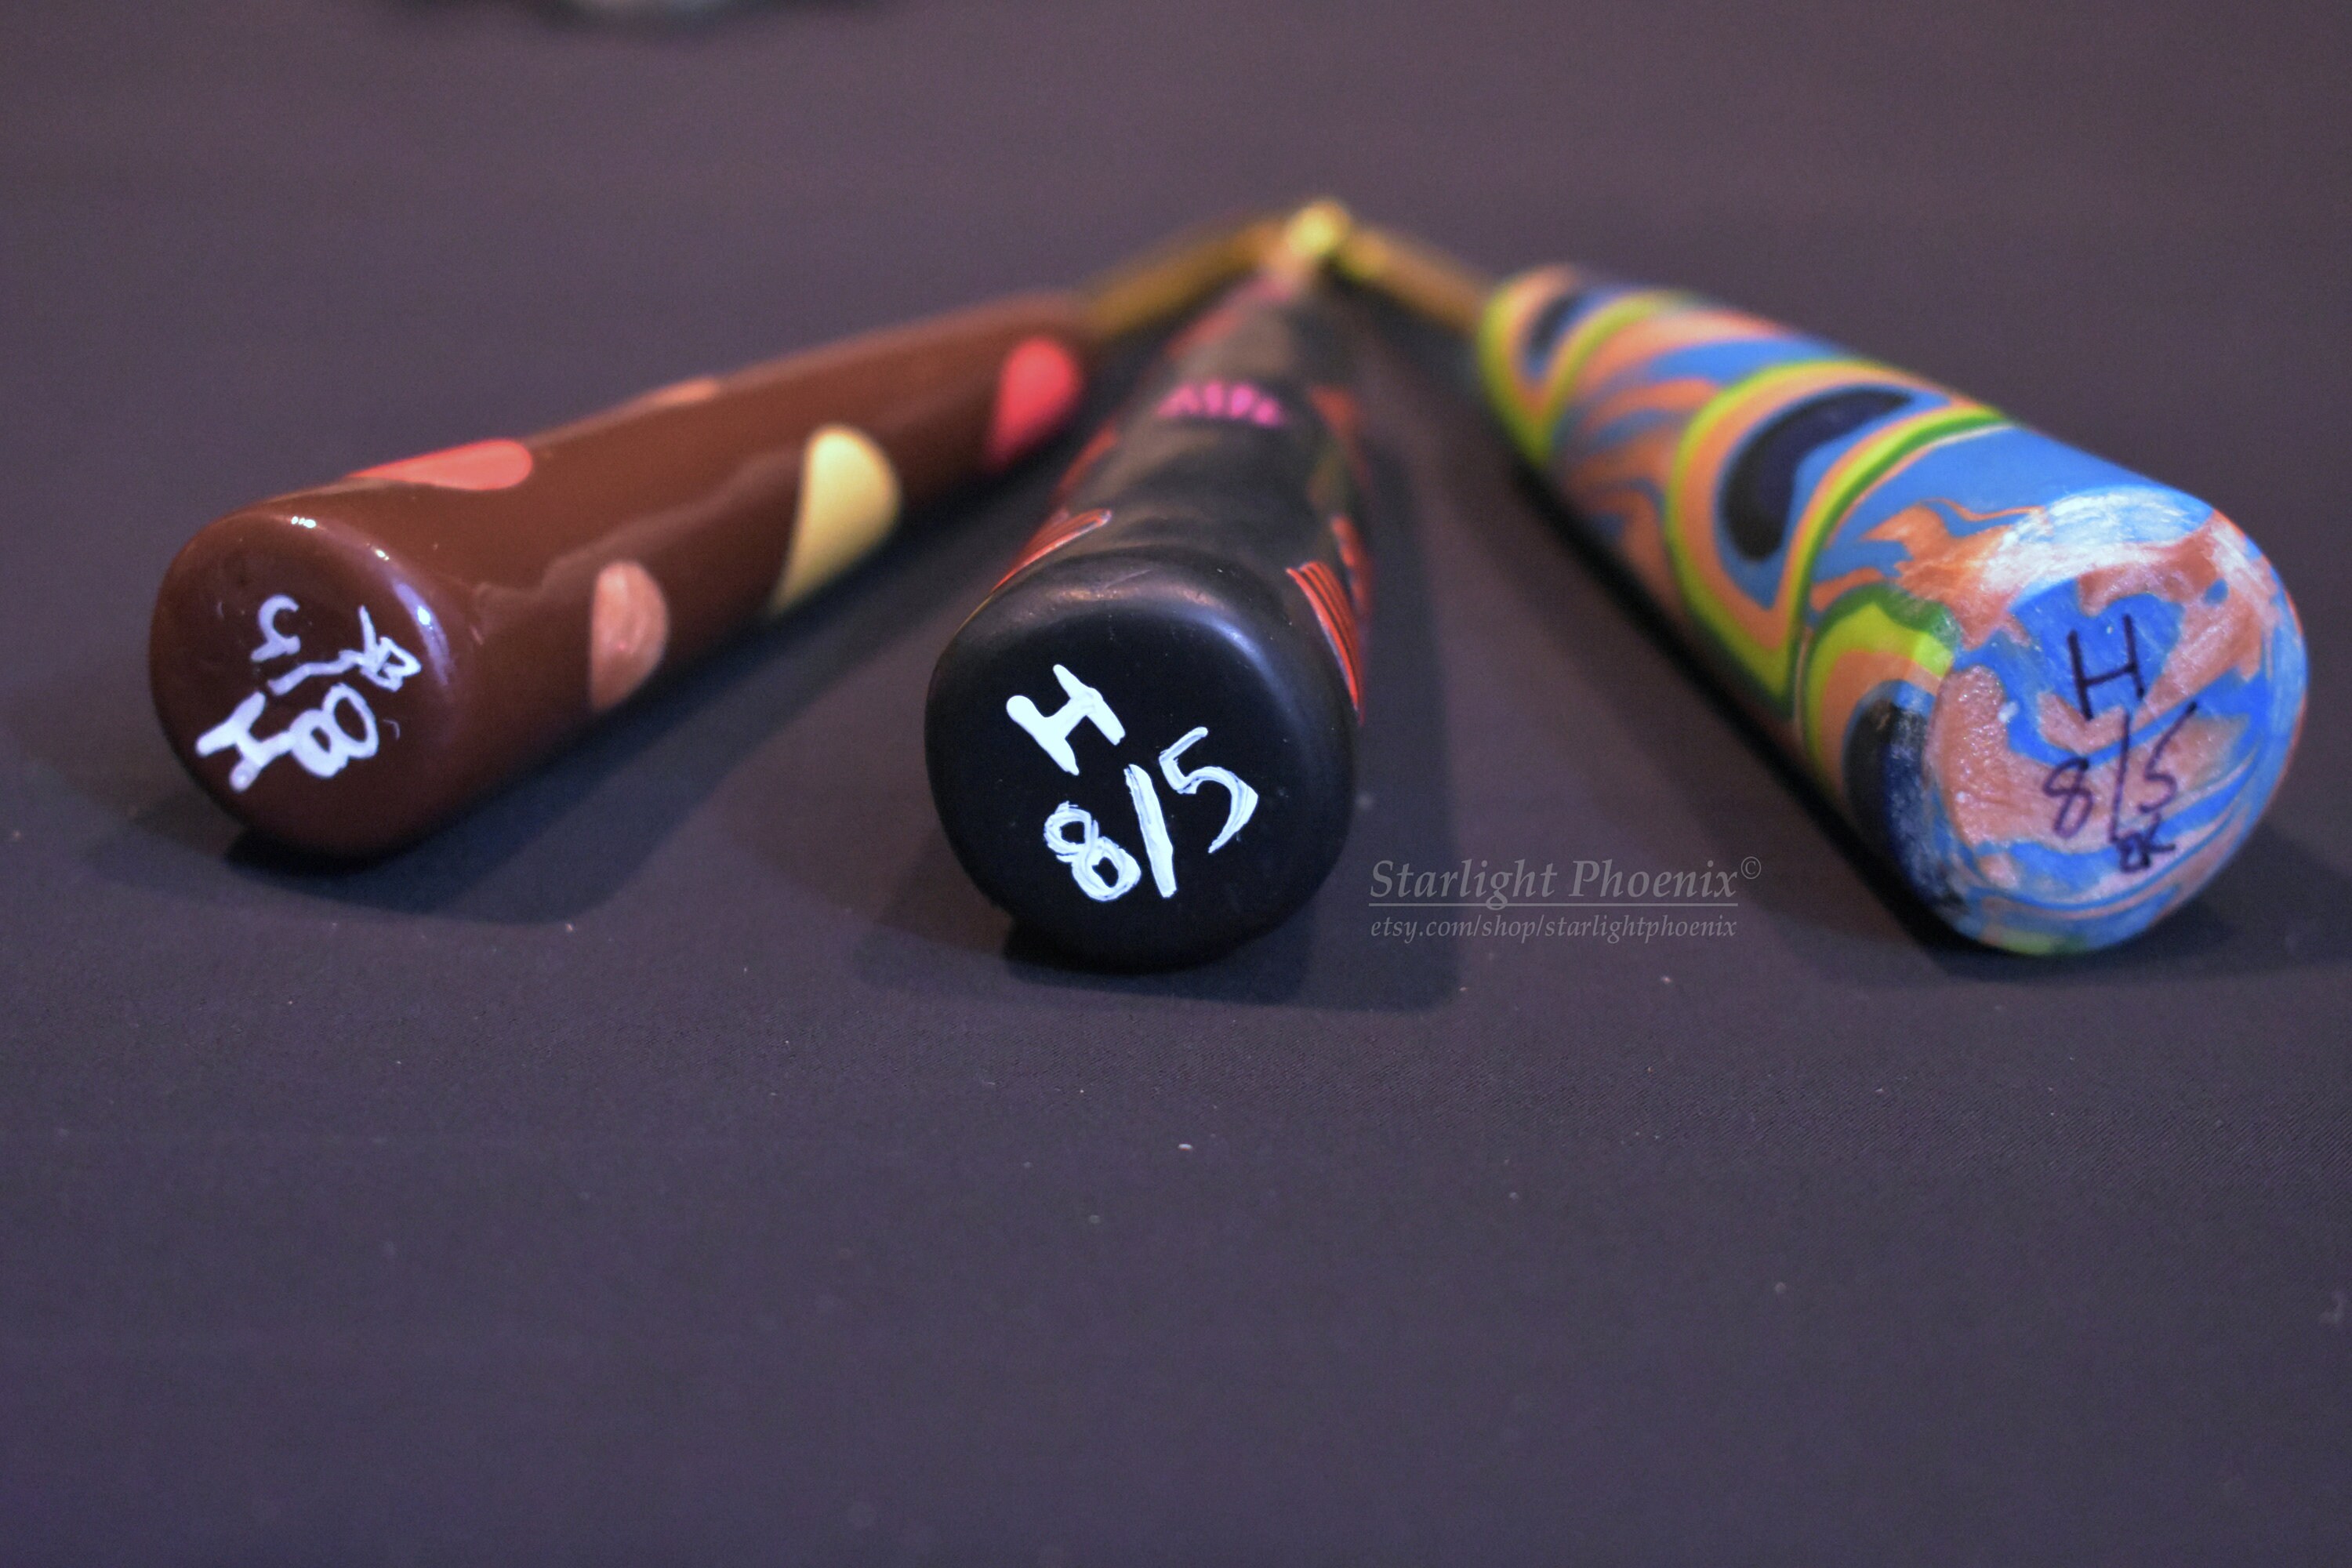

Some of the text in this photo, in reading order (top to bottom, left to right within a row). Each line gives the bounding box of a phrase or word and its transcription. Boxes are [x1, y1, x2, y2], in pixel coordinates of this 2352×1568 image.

[1006, 663, 1126, 776] H
[2066, 613, 2147, 721] H
[1044, 726, 1259, 902] 8/5
[2041, 700, 2199, 844] 8/5
